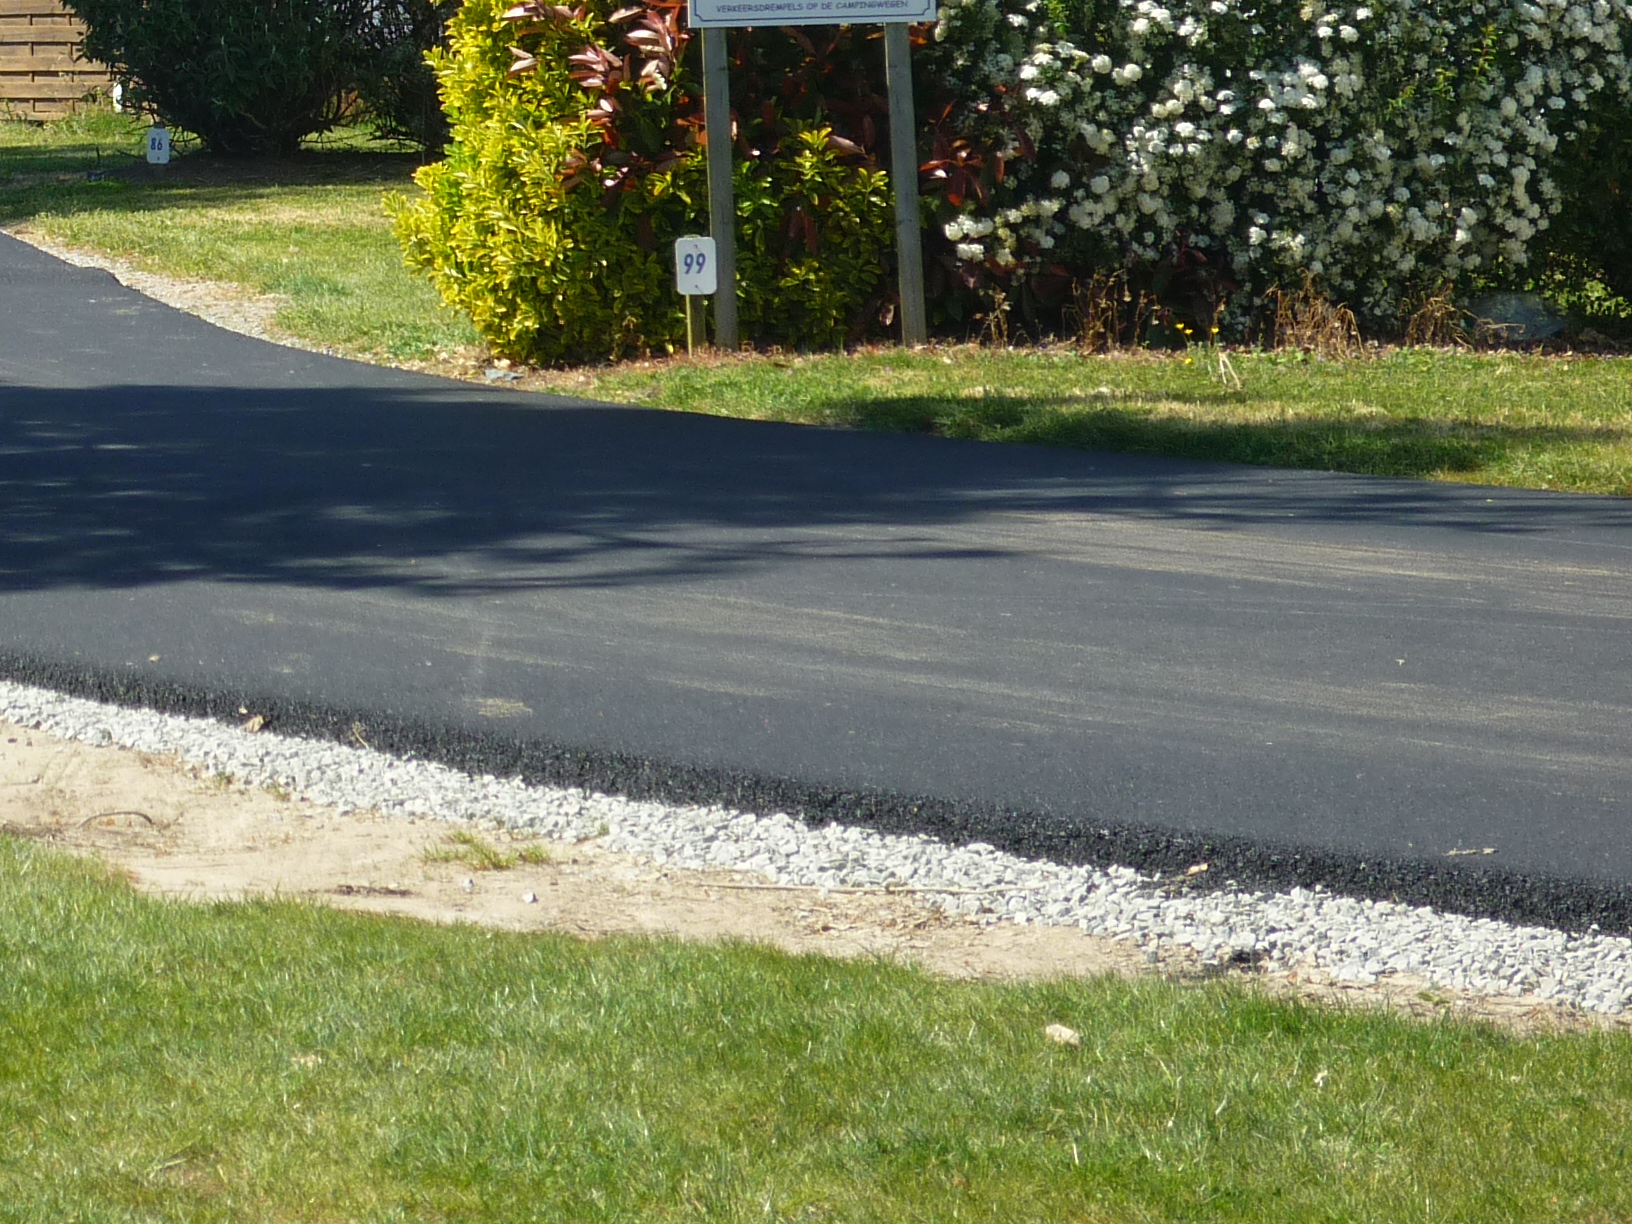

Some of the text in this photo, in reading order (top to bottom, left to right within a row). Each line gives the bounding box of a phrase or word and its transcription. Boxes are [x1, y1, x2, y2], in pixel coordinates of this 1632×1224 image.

[716, 0, 908, 13] VERKEERSDREMPELS OP DE CAMPINGWEGEN
[150, 137, 163, 151] 86
[684, 253, 707, 275] 99
